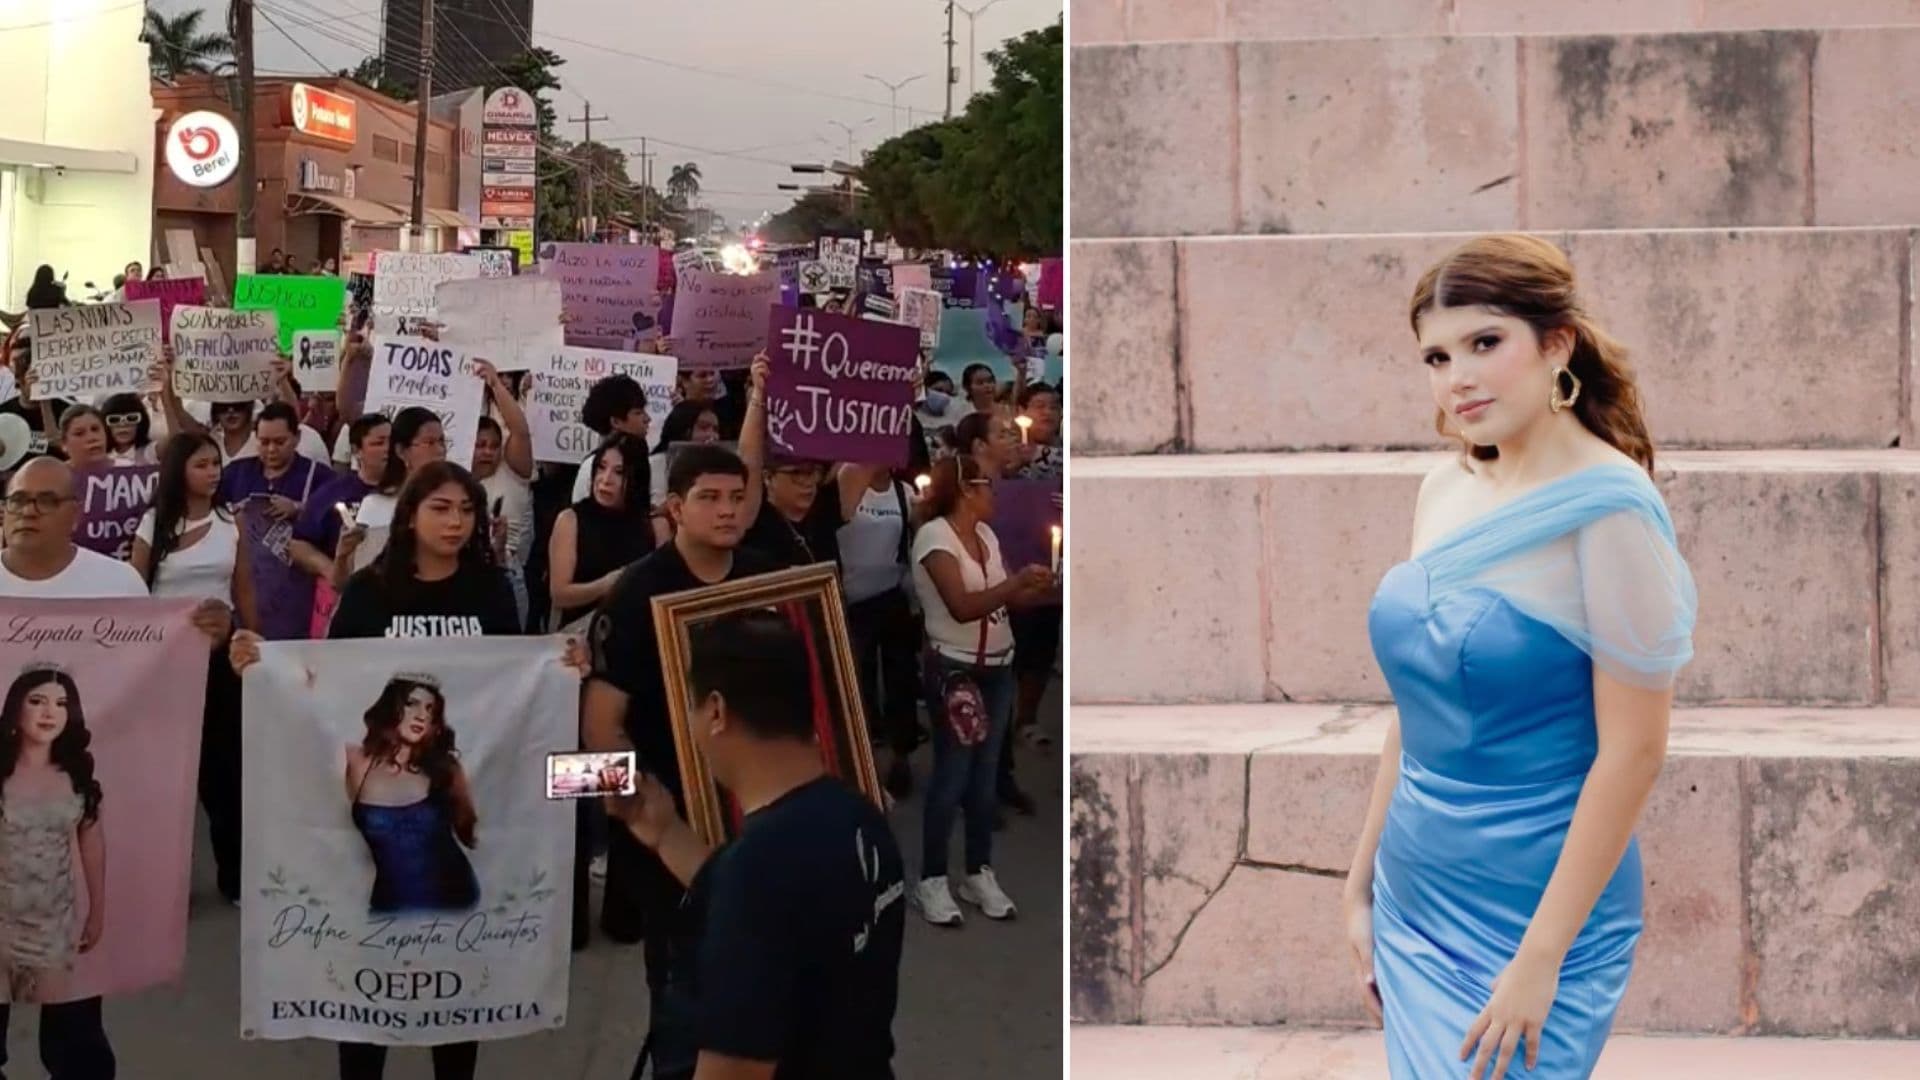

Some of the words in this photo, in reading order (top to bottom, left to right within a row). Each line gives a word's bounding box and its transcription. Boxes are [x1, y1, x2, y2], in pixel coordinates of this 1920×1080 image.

[487, 131, 533, 142] HELVEX
[192, 150, 231, 178] Berel
[34, 311, 75, 338] LAS
[175, 333, 219, 357] DAFNE
[220, 332, 278, 357] QUINTOS
[384, 342, 453, 378] TODAS
[584, 356, 606, 375] NO
[40, 372, 123, 396] JUSTICIA
[550, 409, 570, 423] NO
[794, 384, 913, 437] JUSTICIA
[1, 614, 84, 651] Zapata
[92, 616, 165, 649] Quintos
[384, 615, 484, 639] JUSTICIA
[268, 904, 351, 950] Dafne
[357, 914, 453, 960] Zapata
[455, 911, 542, 953] Quintos
[354, 967, 463, 1003] QEPD
[271, 1000, 408, 1029] EXIGIMOS
[415, 1000, 542, 1029] JUSTICIA
